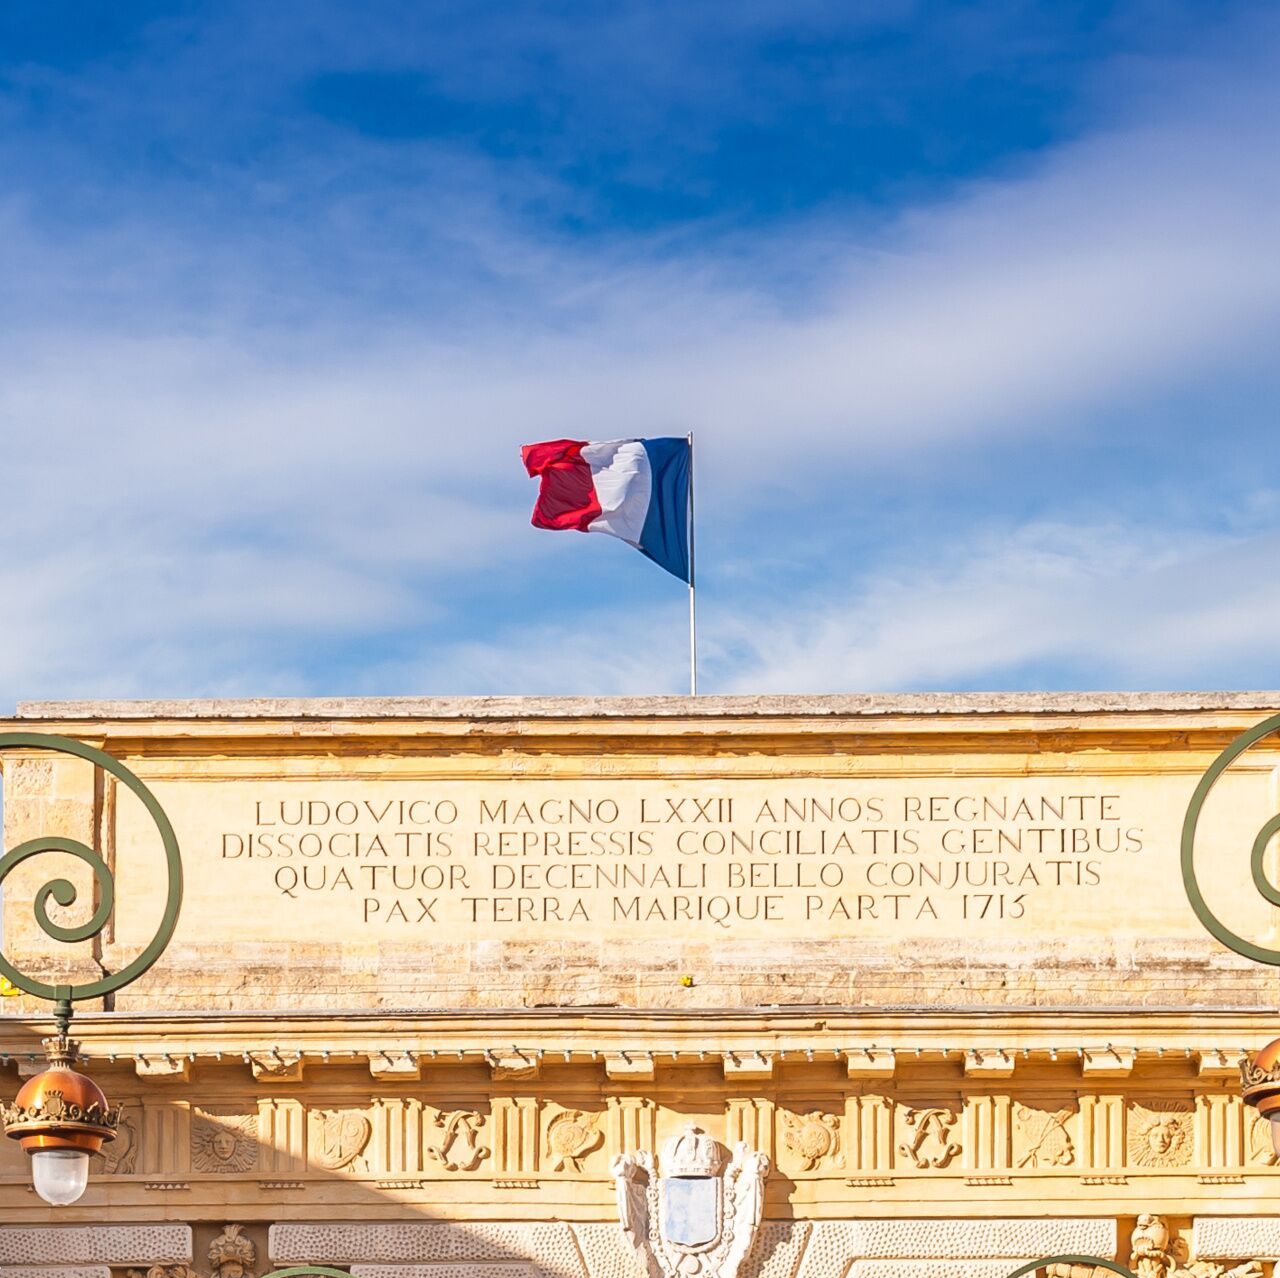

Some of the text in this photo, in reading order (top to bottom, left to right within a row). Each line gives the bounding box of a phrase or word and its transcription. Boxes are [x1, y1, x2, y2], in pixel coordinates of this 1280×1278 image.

[255, 794, 1121, 827] LUDOVICO MAGNO LXXII ANNOS REGNANTE
[221, 827, 1144, 859] DISSOCIATIS REPRESSIS CONCILIATIS GENTIBUS
[274, 860, 1102, 899] QUATUOR DECENNALI BELLO CONJURATIS
[363, 893, 1029, 928] PAX TERRA MARIQUE PARTA 1715
